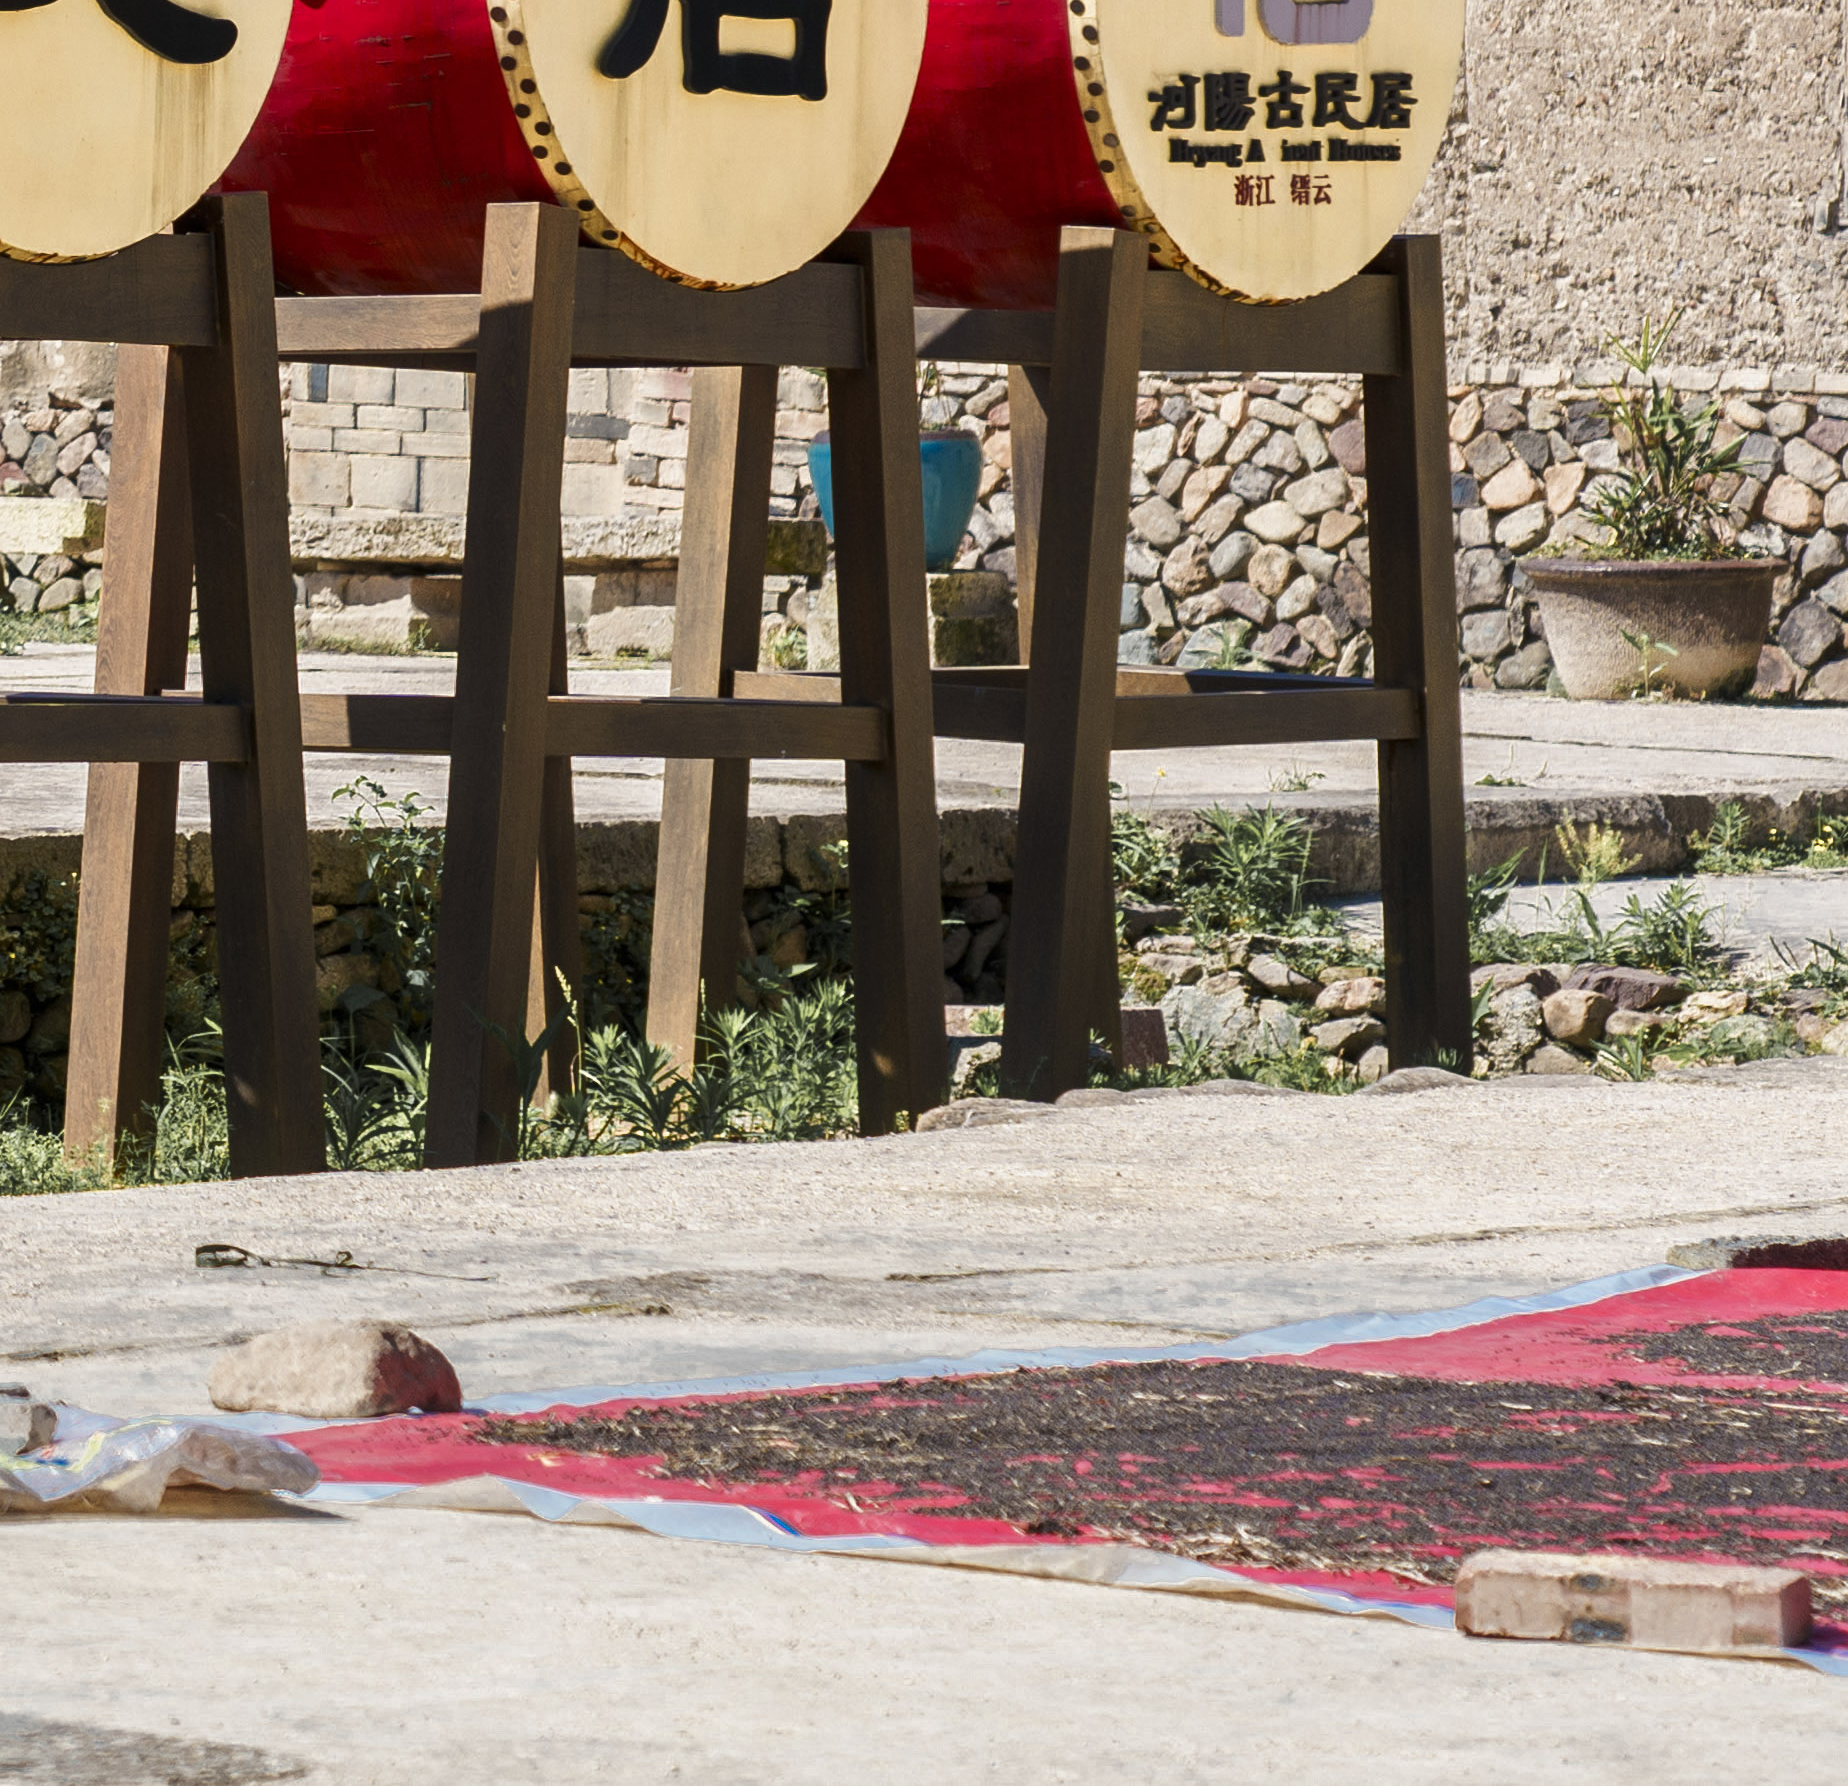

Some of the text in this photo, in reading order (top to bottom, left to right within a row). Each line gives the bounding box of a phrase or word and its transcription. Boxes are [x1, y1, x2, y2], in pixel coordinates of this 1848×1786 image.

[1326, 137, 1401, 163] Houses
[1233, 173, 1333, 207] 浙江 缙云
